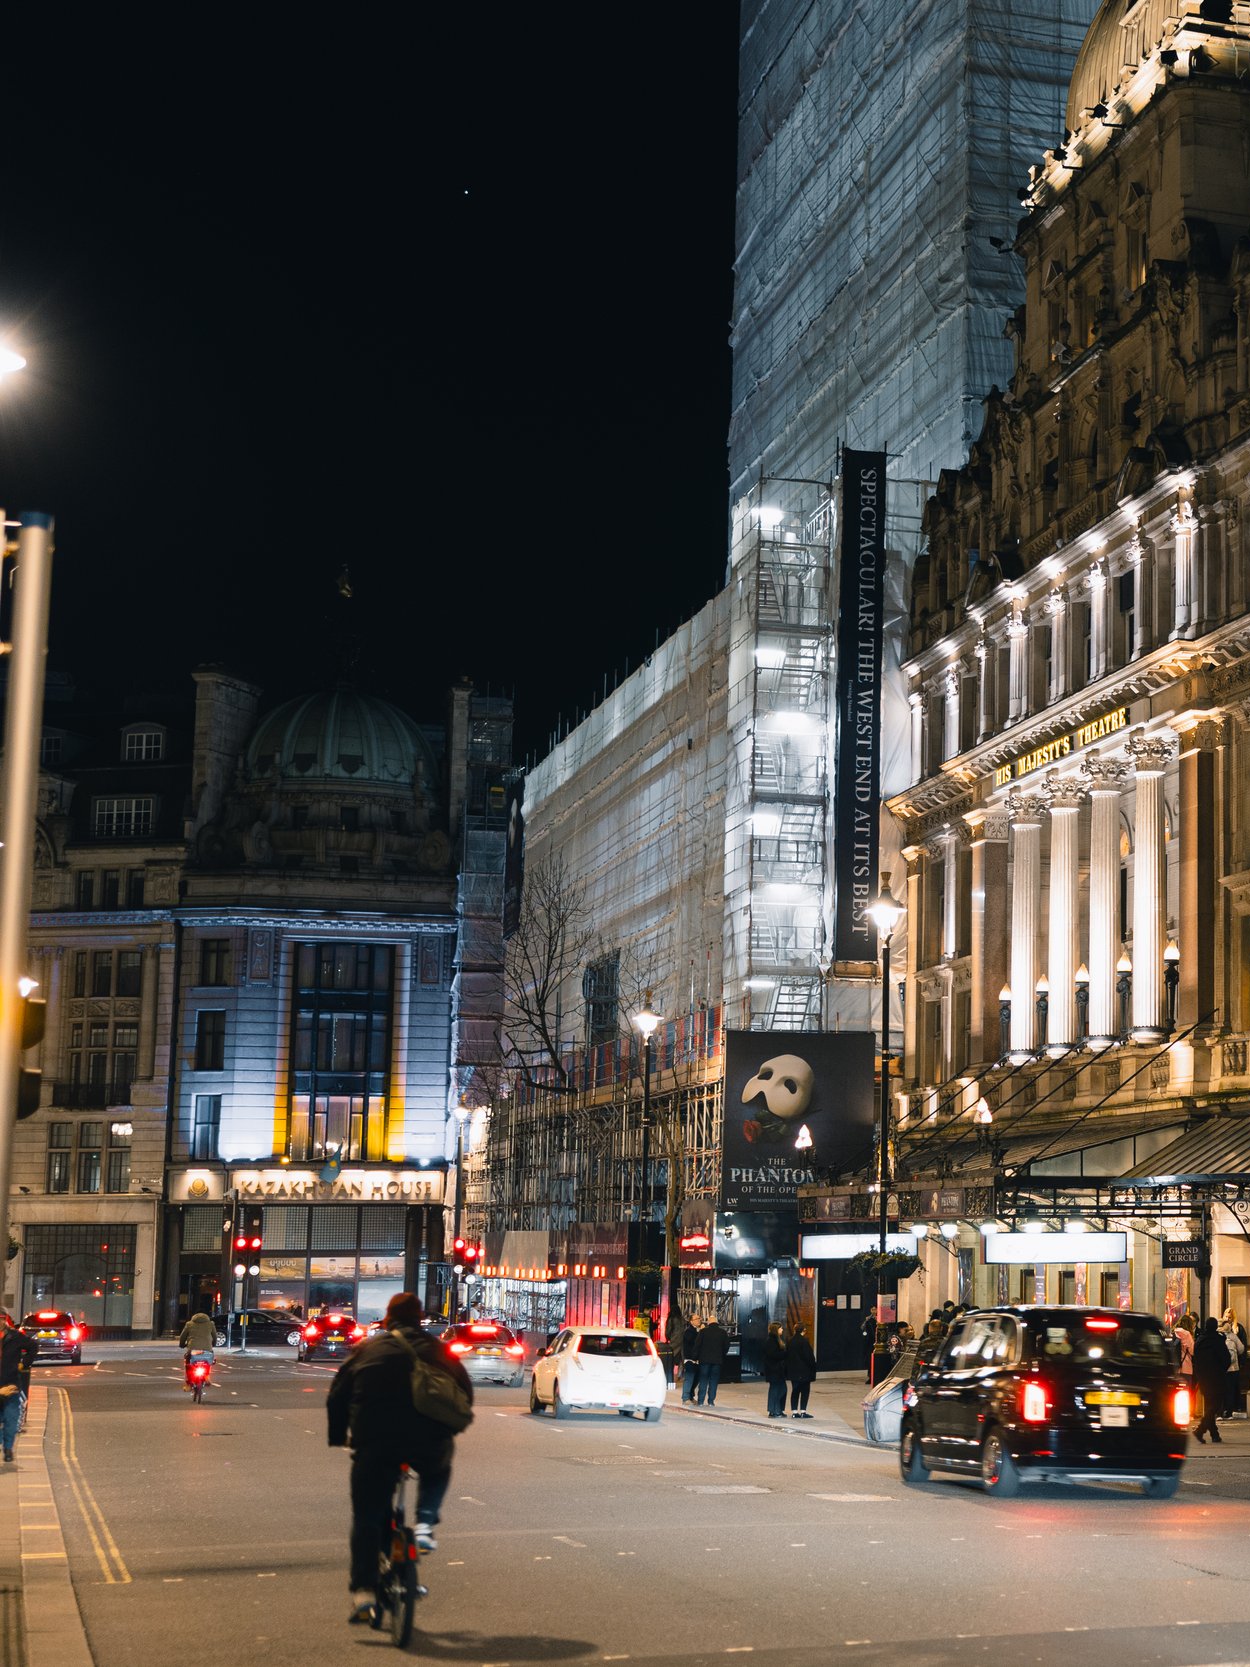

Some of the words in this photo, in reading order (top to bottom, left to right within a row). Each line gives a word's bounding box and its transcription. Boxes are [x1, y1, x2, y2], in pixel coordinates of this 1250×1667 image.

[857, 639, 875, 684] THE
[856, 690, 874, 750] WEST
[995, 763, 1012, 787] HIS
[1018, 735, 1070, 776] MAJESTY'S
[1077, 707, 1126, 747] THEATRE
[855, 755, 872, 802] END
[854, 808, 871, 837] AT
[853, 843, 871, 877] ITS
[767, 1158, 786, 1166] THE
[371, 1180, 432, 1196] HOUSE
[741, 1186, 754, 1194] OF
[757, 1186, 776, 1194] THE
[778, 1186, 797, 1194] OPE
[1168, 1246, 1199, 1255] GRAND
[1168, 1254, 1199, 1262] CIRCLE
